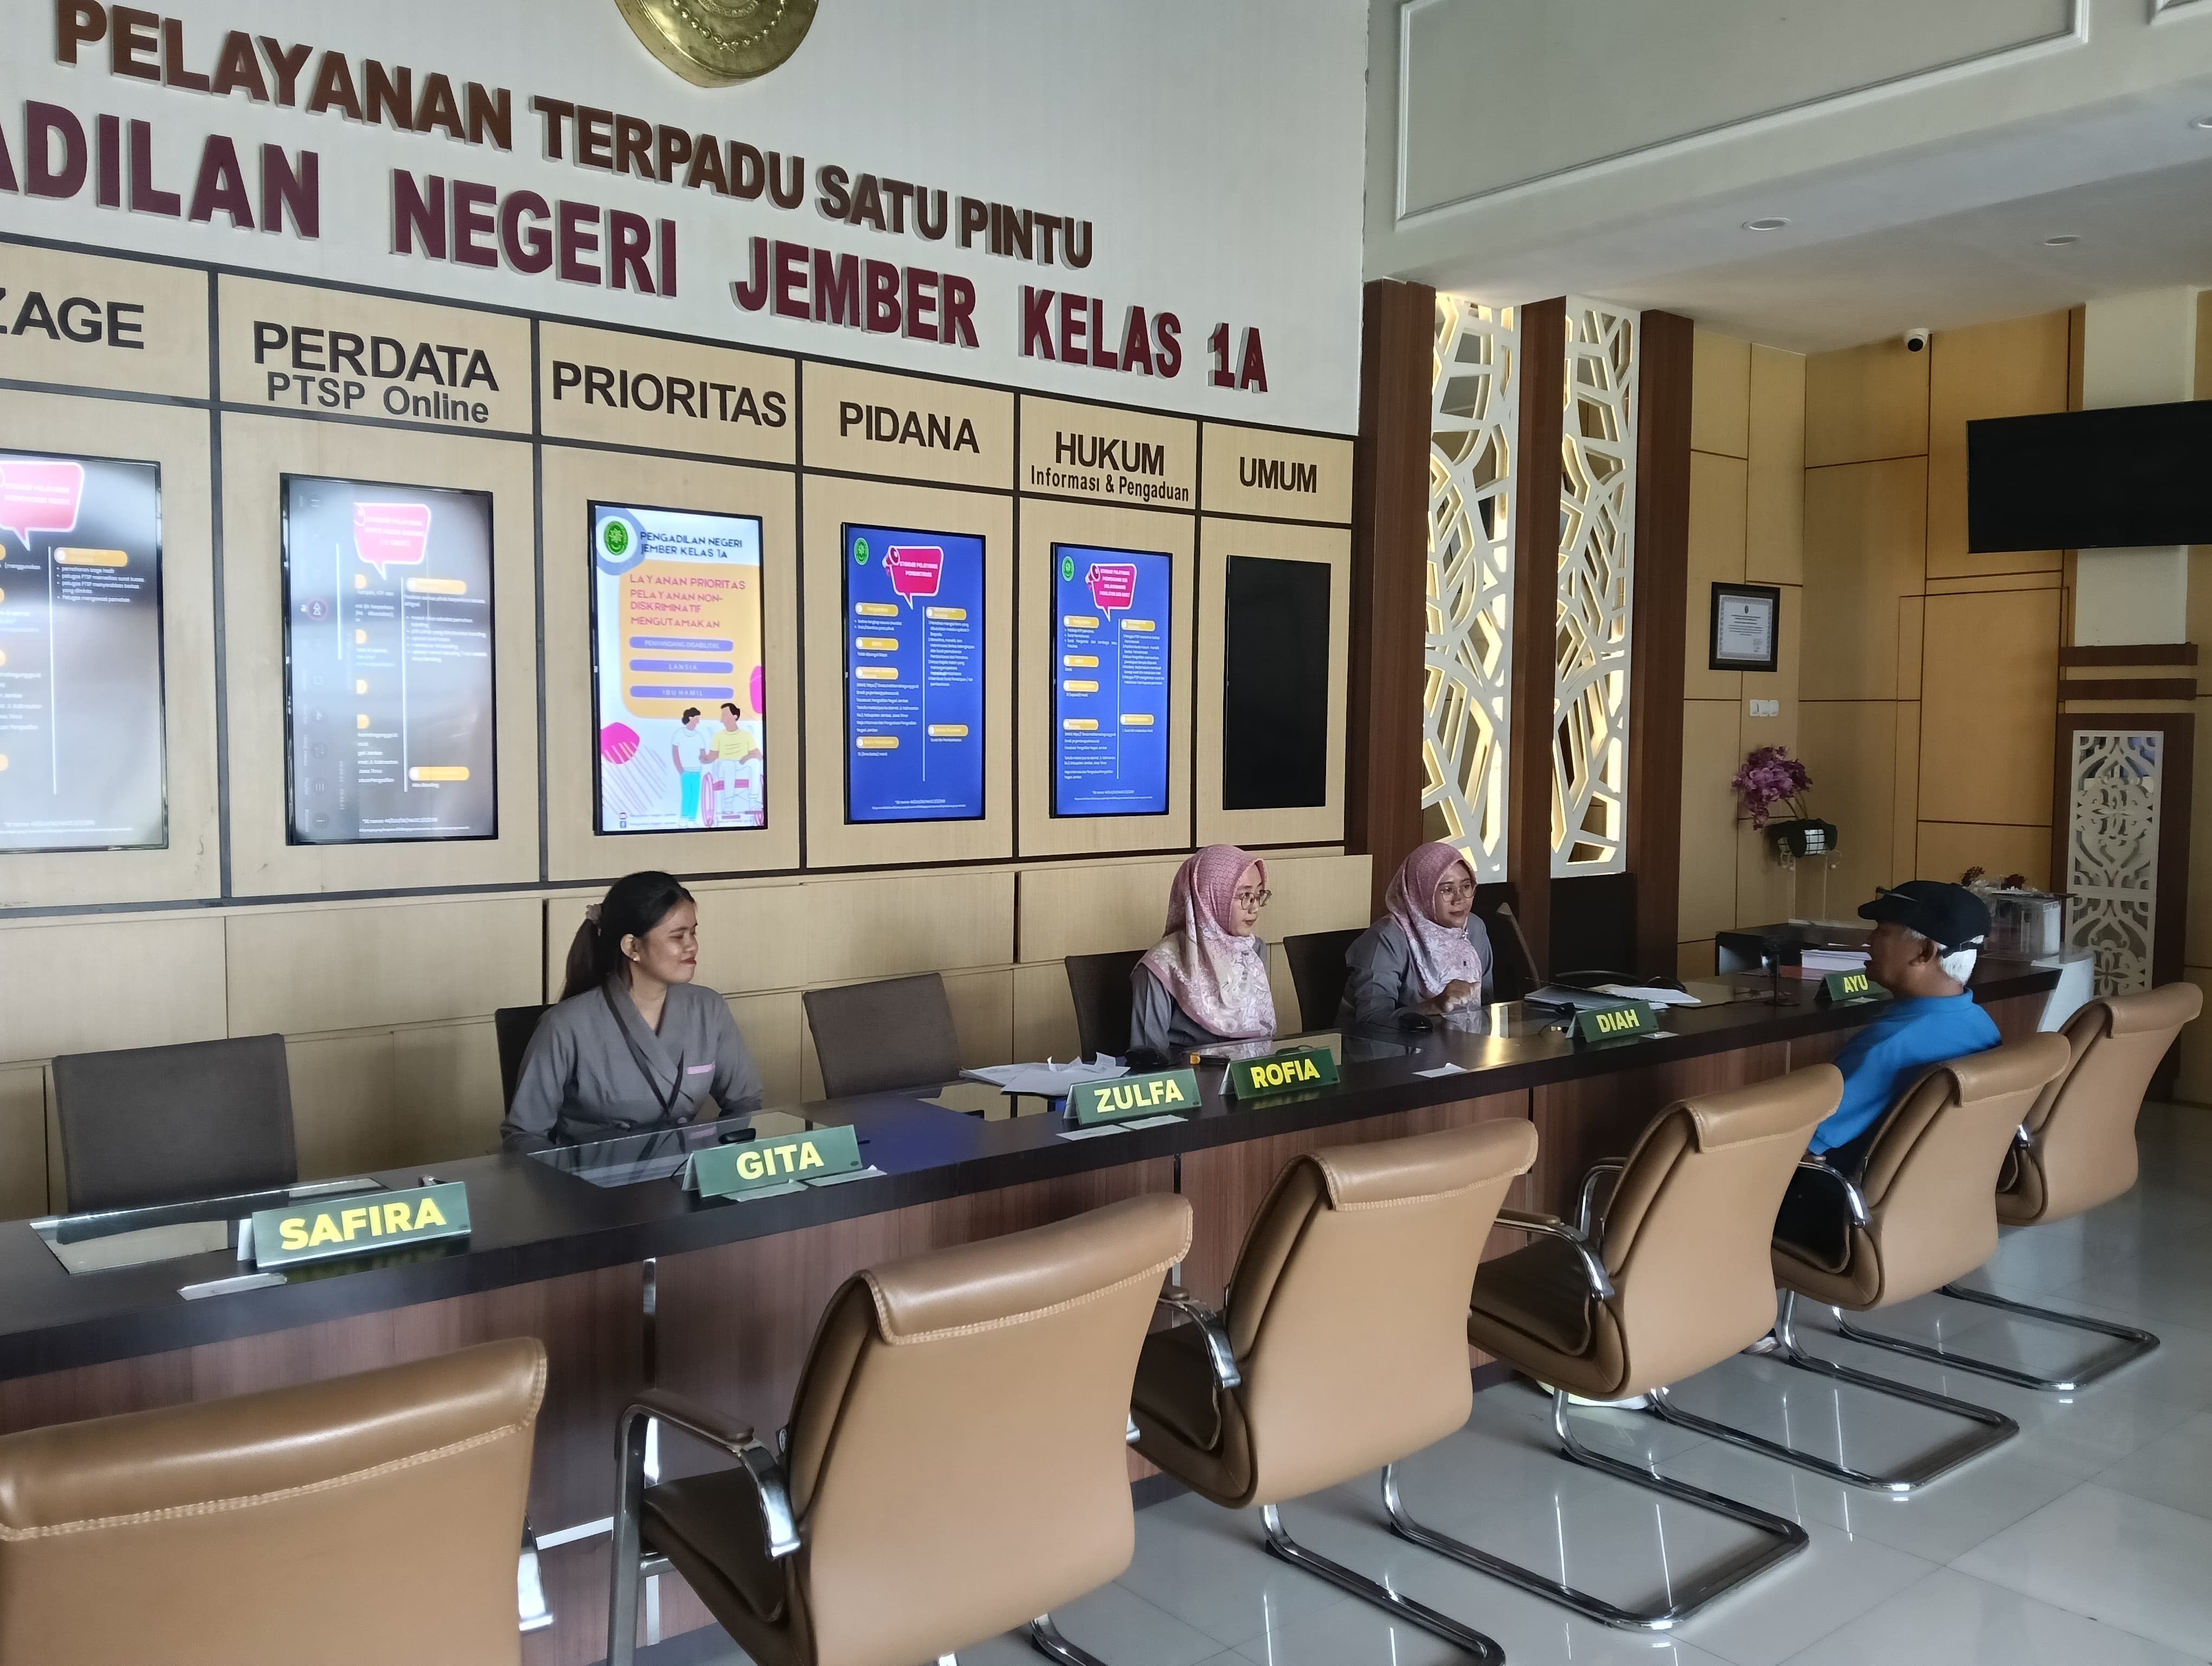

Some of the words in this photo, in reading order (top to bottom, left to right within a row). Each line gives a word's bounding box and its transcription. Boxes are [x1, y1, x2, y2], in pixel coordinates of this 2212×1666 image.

[55, 0, 513, 150] PELAYANAN
[532, 95, 805, 209] TERPADU
[818, 164, 948, 240] SATU
[959, 196, 1092, 268] PINTU
[391, 168, 677, 298] NEGERI
[732, 236, 980, 348] JEMBER
[1020, 285, 1182, 379] KELAS
[1208, 322, 1268, 393] 1A
[0, 287, 144, 350] AGE
[253, 321, 500, 392] PERDATA
[267, 371, 365, 410] PTSP
[383, 385, 489, 424] Online
[552, 360, 787, 428] PRIORITAS
[840, 401, 980, 454] PIDANA
[1056, 431, 1165, 477] HUKUM
[1031, 465, 1100, 492] Informasi
[1105, 474, 1115, 494] &
[1119, 476, 1189, 503] Pengaduan
[1239, 456, 1317, 494] UMUM
[640, 531, 705, 544] PENGADILAN
[708, 537, 742, 548] NEGERI
[640, 543, 677, 555] JEMBER
[680, 547, 714, 558] KELAS
[717, 549, 728, 558] 1A
[690, 578, 746, 589] PRIORITAS
[630, 601, 702, 613] DISKRIMINATIF
[631, 617, 720, 628] MENGUTAMAKAN
[1843, 974, 1869, 994] AYU
[1596, 1009, 1640, 1033] DIAH
[1250, 1058, 1321, 1089] ROFIA
[1094, 1079, 1185, 1113] ZULFA
[736, 1140, 825, 1181] GITA
[278, 1197, 448, 1251] SAFIRA
